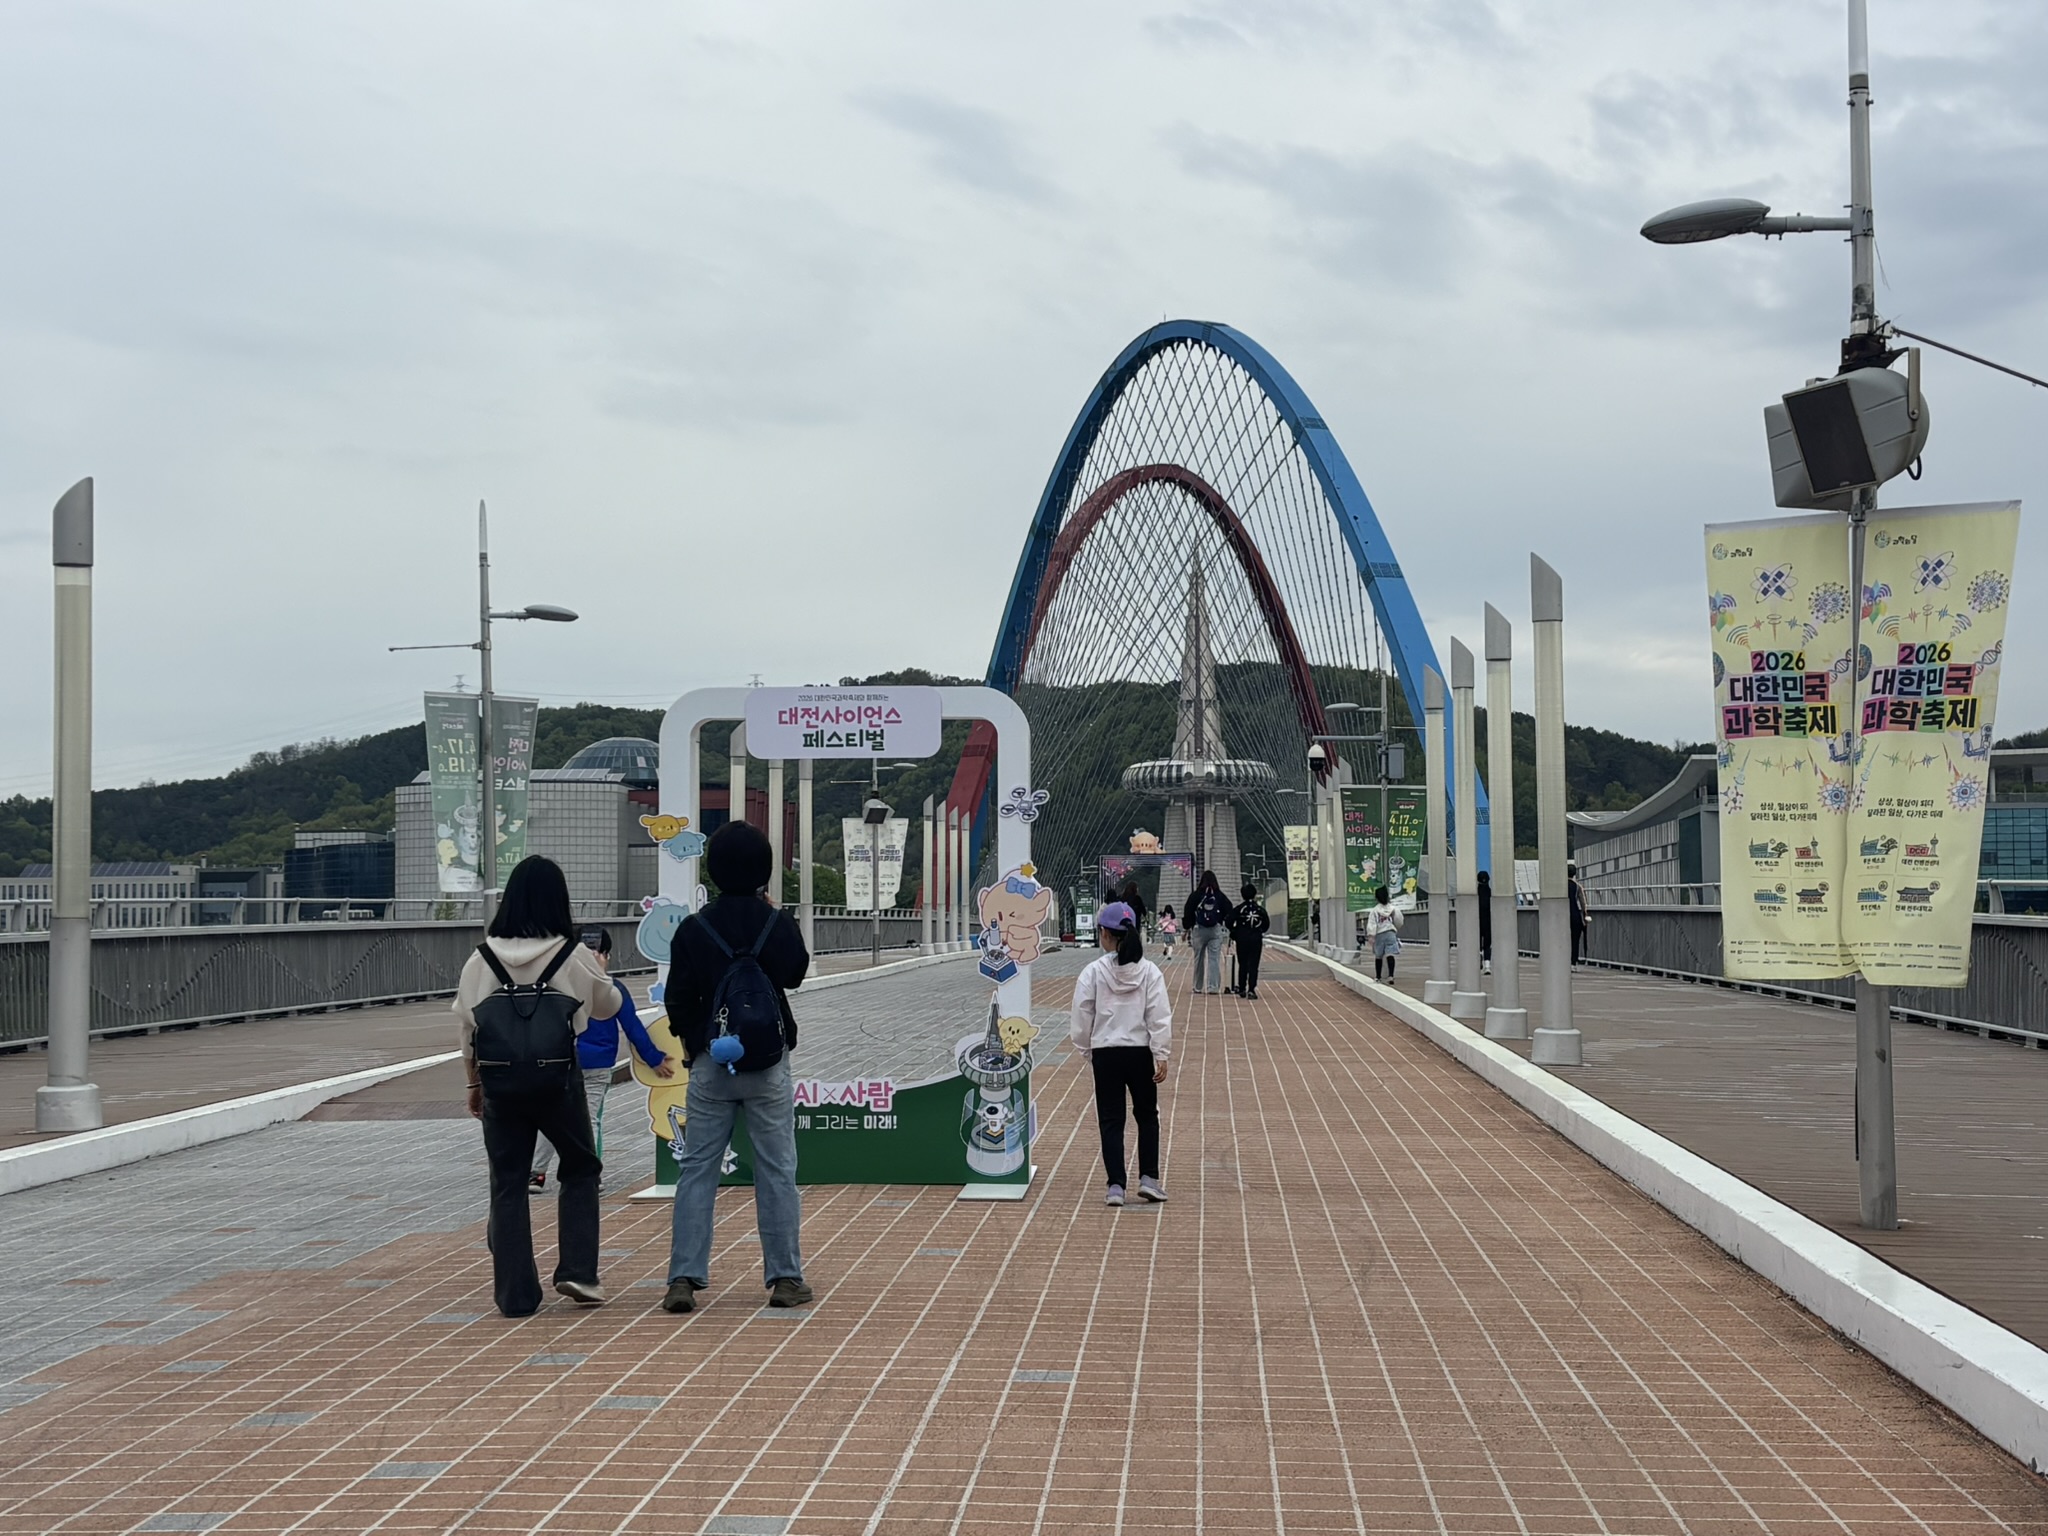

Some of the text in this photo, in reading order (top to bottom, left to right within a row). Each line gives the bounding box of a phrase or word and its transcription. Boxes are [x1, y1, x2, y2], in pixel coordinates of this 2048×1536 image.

[1752, 652, 1805, 672] 2026
[1899, 643, 1951, 666] 2026
[1729, 674, 1827, 702] 대한민국
[1871, 664, 1973, 697] 대한민국
[777, 706, 903, 729] 대전사이언스
[1725, 705, 1837, 736] 과학축제
[1862, 699, 1979, 731] 과학축제
[802, 729, 886, 751] 페스티벌
[1344, 811, 1364, 823] 대전
[795, 1115, 898, 1130] 께 그리는 미래!
